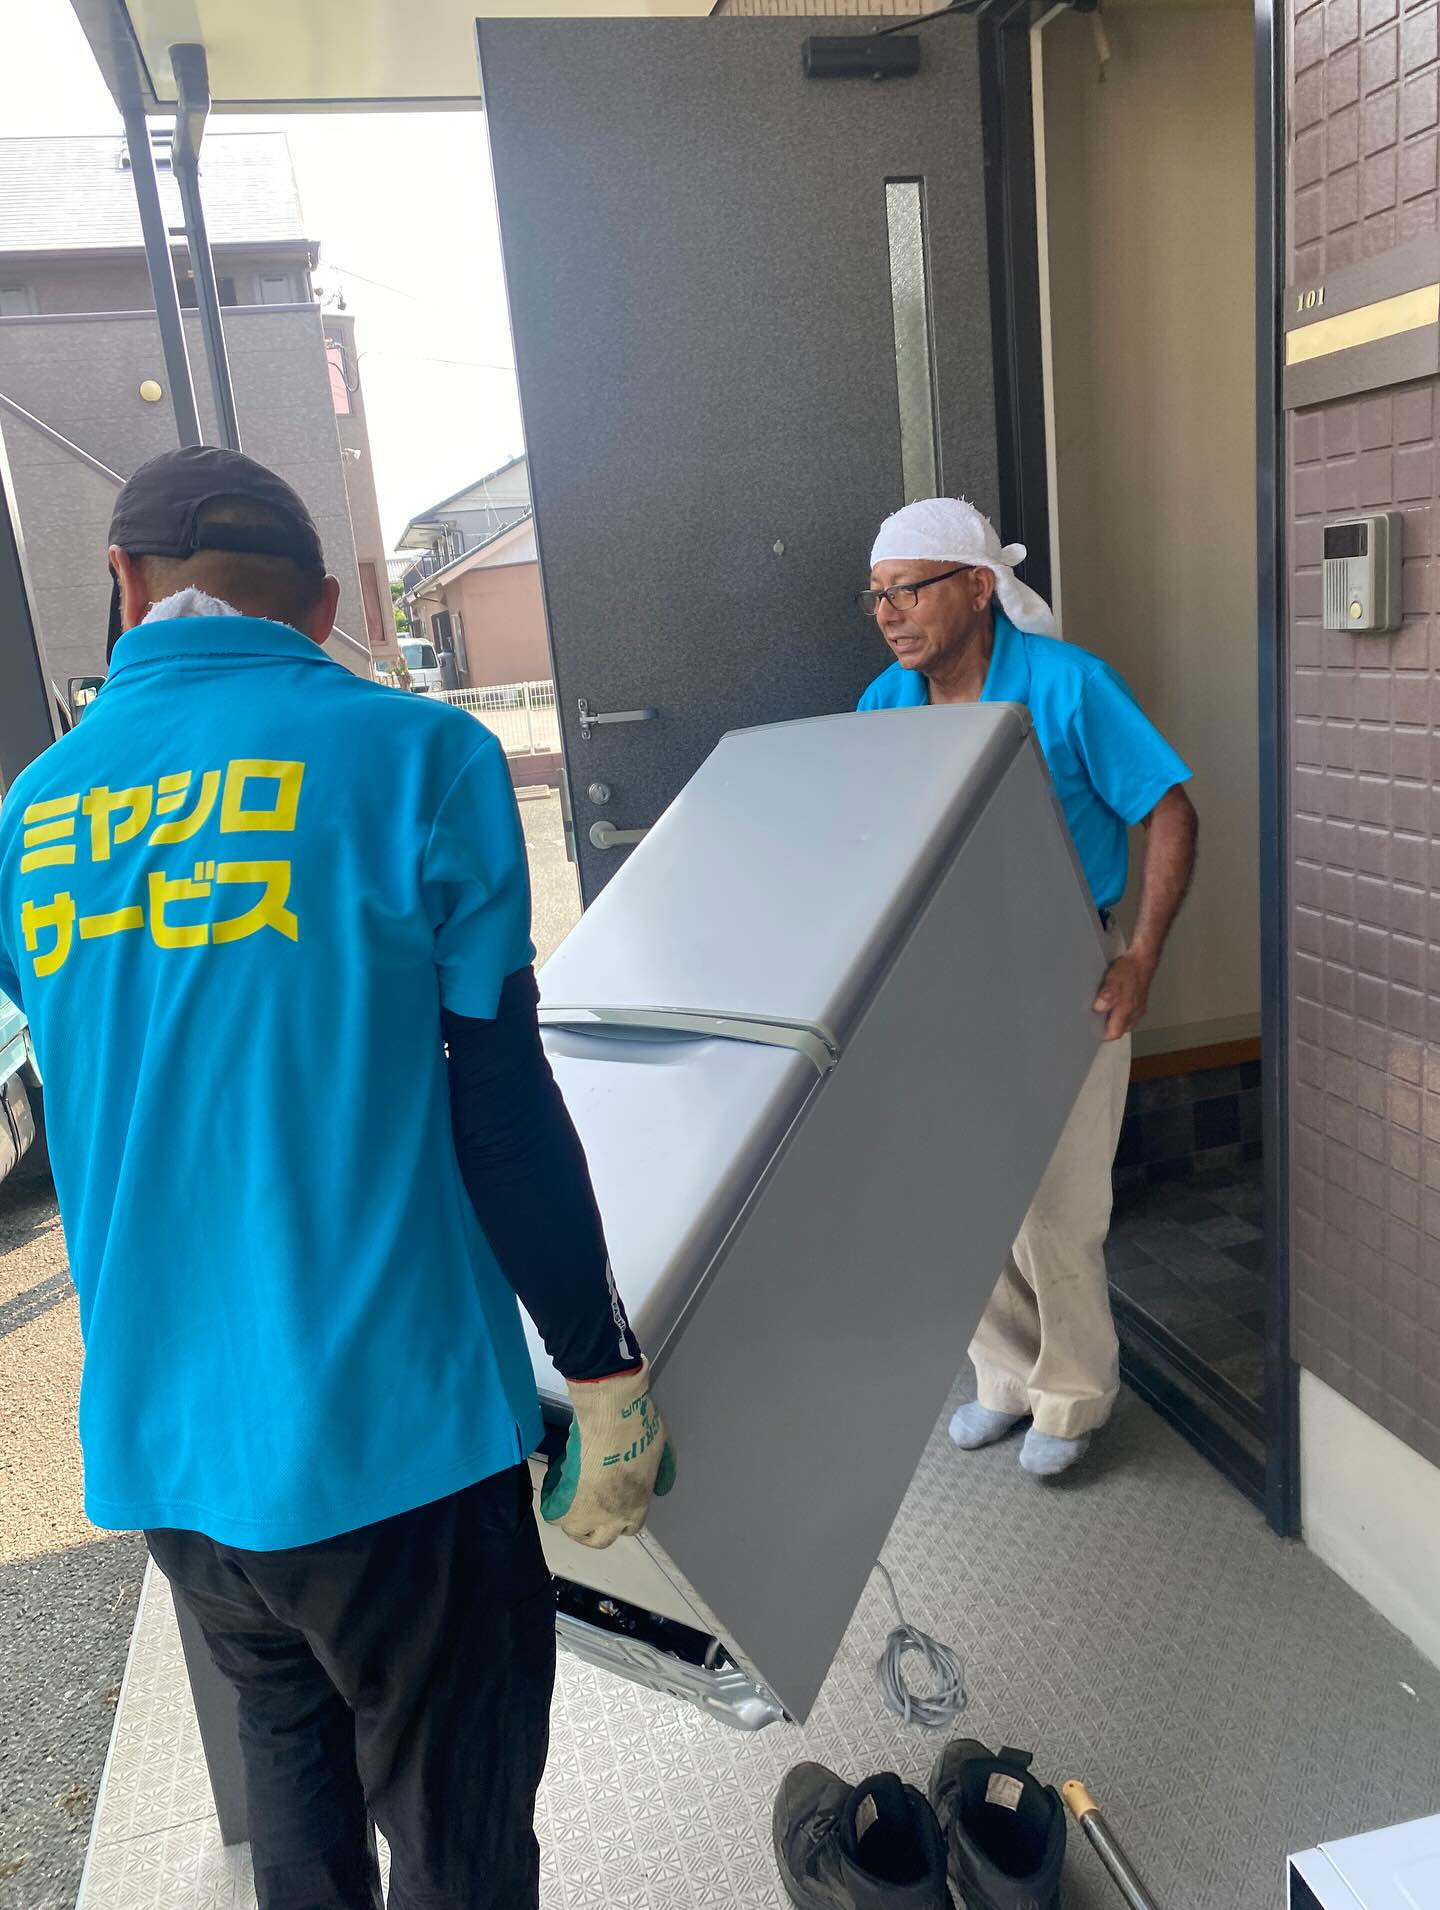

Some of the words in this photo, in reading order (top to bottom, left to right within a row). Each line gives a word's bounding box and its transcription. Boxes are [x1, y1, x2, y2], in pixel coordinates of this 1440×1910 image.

[1297, 286, 1326, 312] 101
[20, 759, 305, 874] ミヤシロ
[20, 860, 298, 977] サービス
